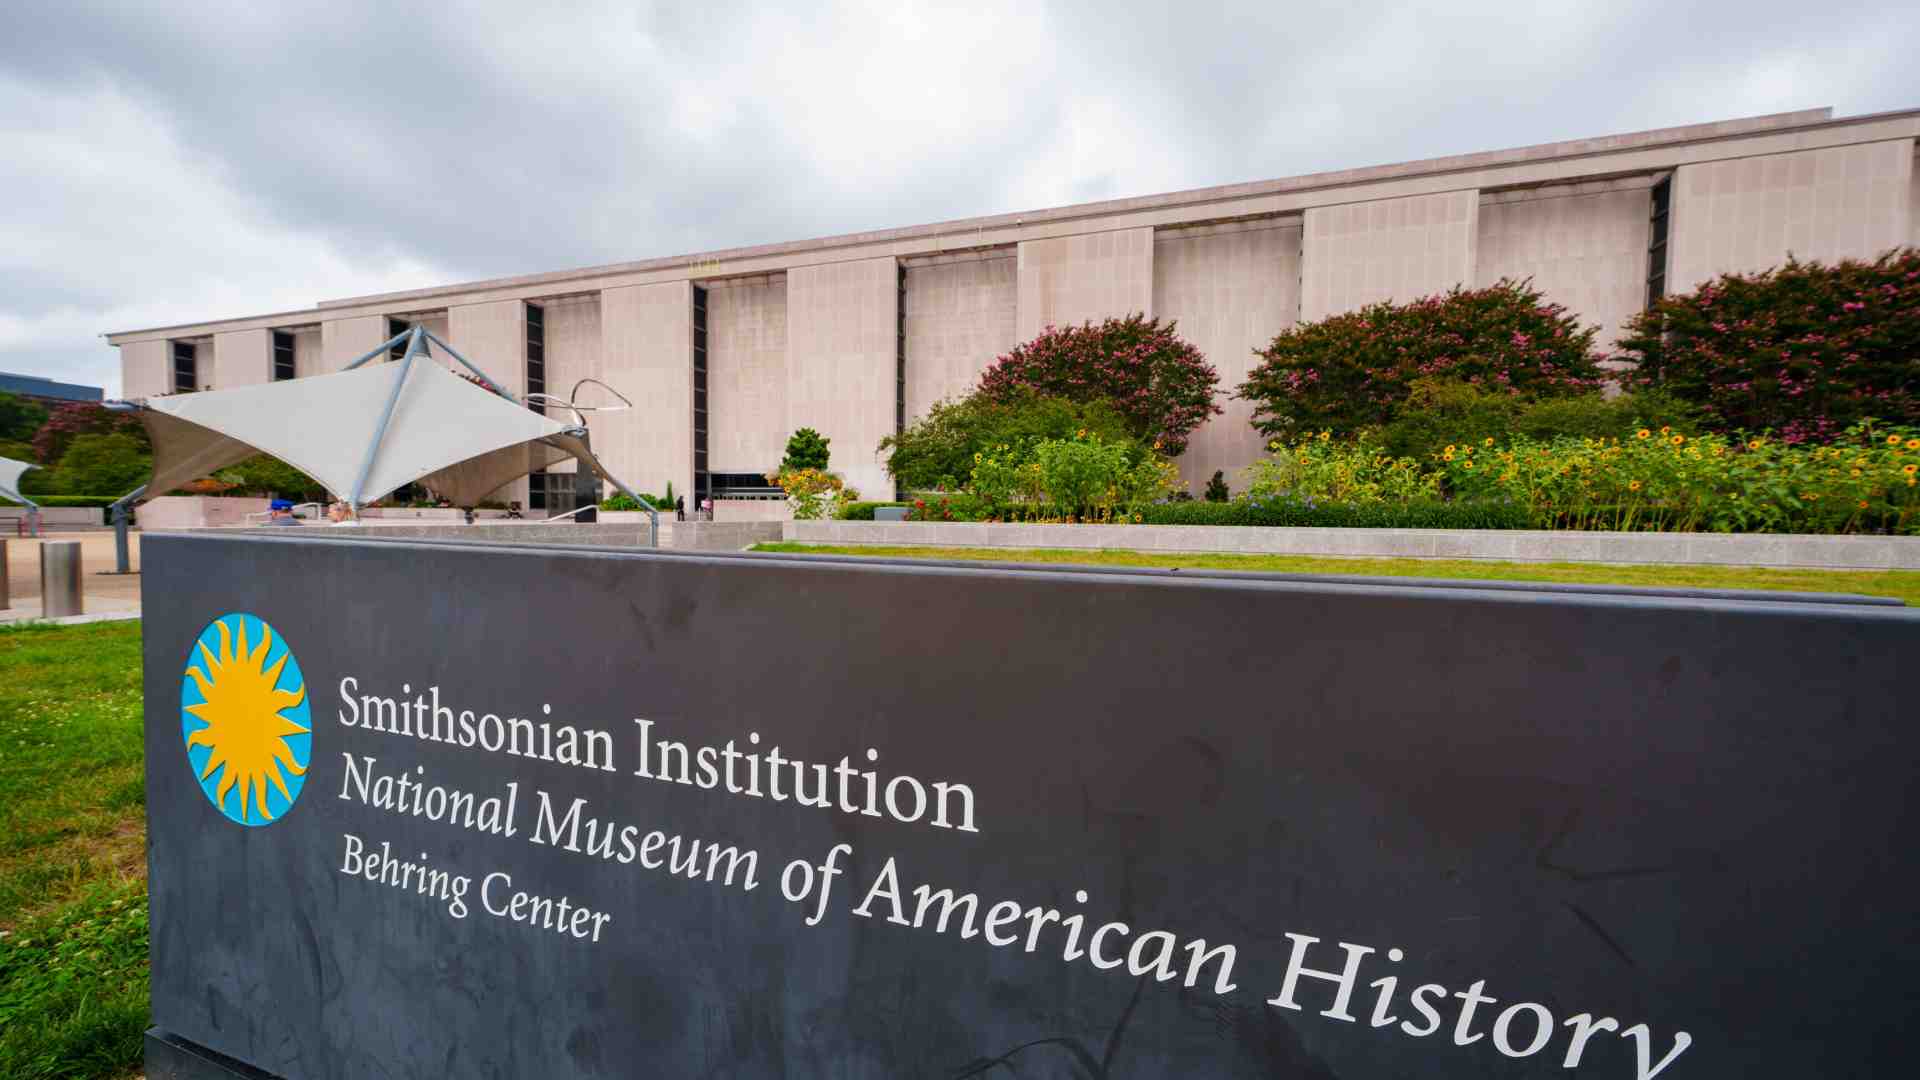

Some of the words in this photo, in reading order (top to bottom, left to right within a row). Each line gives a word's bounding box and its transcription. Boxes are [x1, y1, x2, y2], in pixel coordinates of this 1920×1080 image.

[338, 676, 615, 774] Smithsonian
[633, 717, 981, 834] Institution
[338, 751, 518, 839] National
[528, 790, 762, 892] Museum
[780, 842, 853, 927] of
[852, 856, 1240, 994] American
[1267, 931, 1692, 1080] History
[339, 833, 470, 919] Behring
[480, 872, 611, 943] Center
